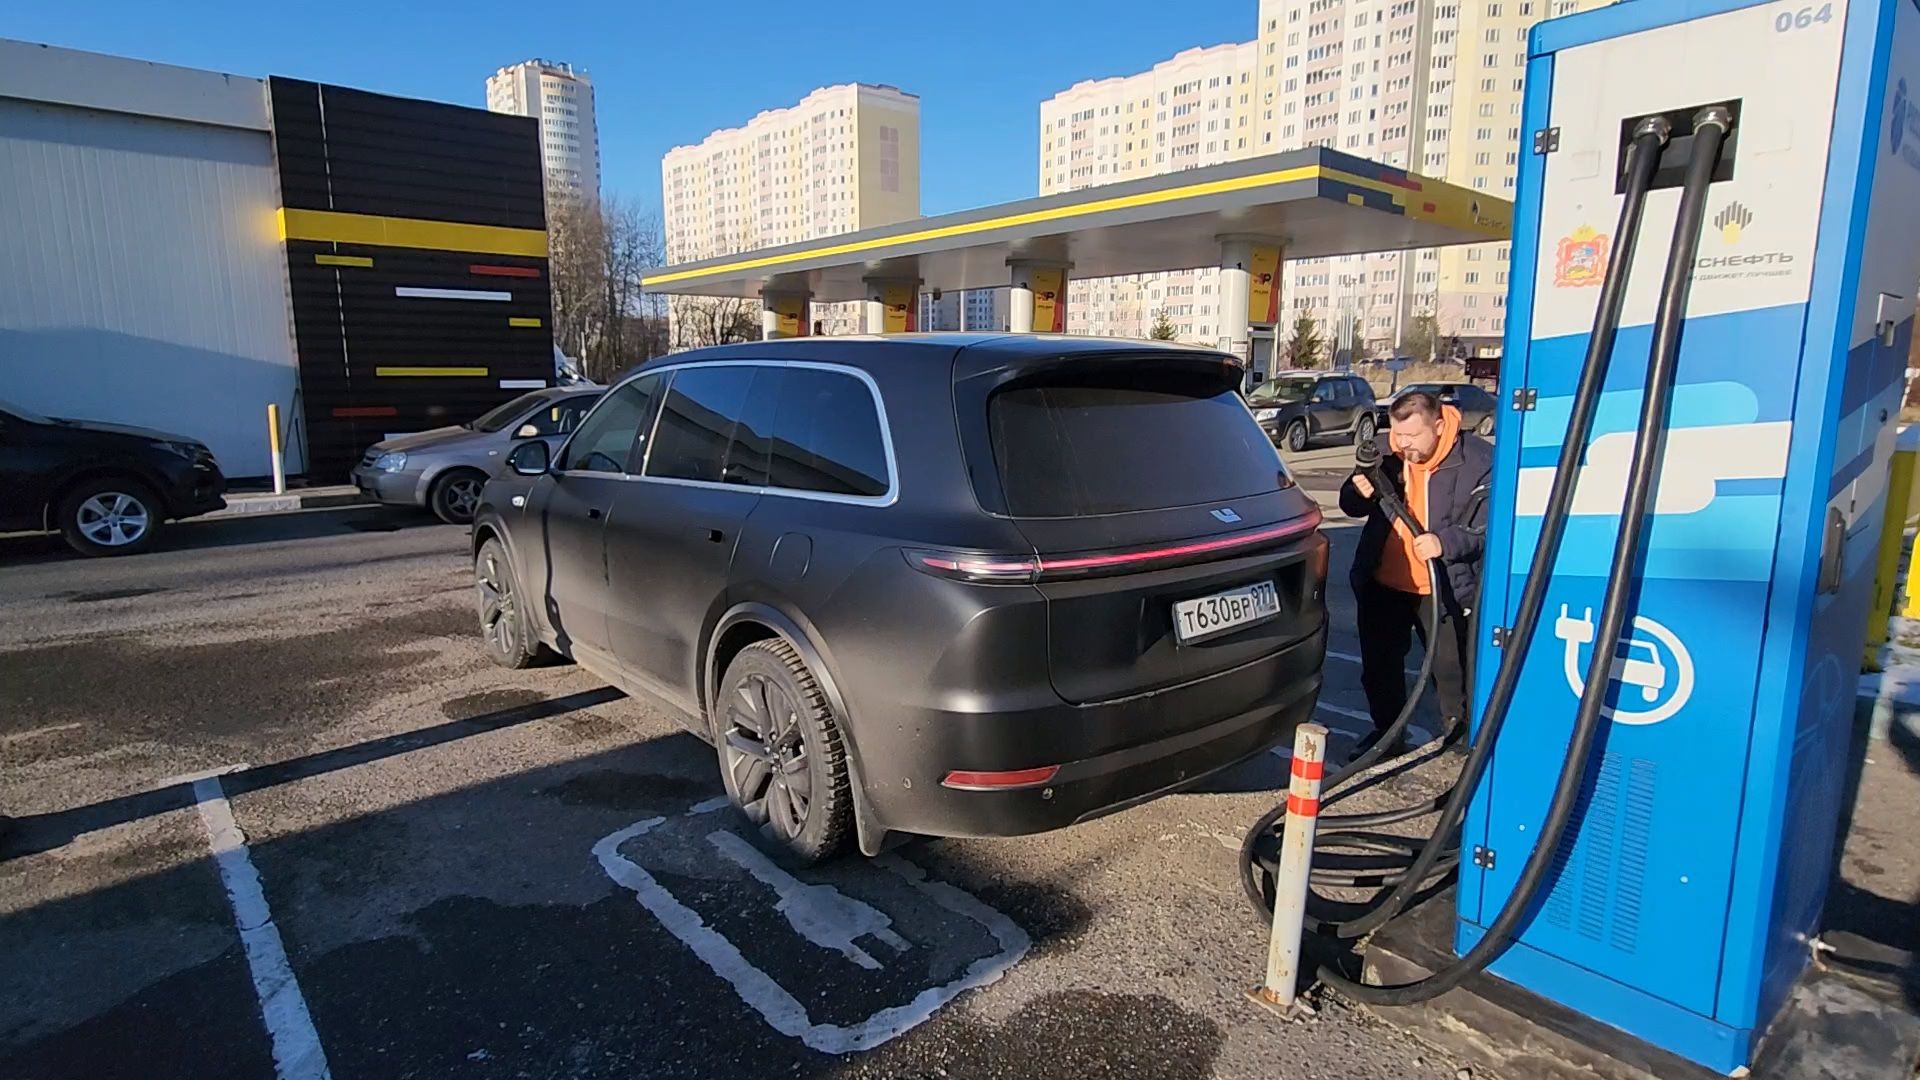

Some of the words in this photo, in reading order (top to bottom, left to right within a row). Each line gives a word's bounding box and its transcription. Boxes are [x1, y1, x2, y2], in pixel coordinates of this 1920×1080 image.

[1775, 3, 1833, 33] 064
[1692, 252, 1794, 269] СНЕФТЬ
[1250, 583, 1274, 607] 977
